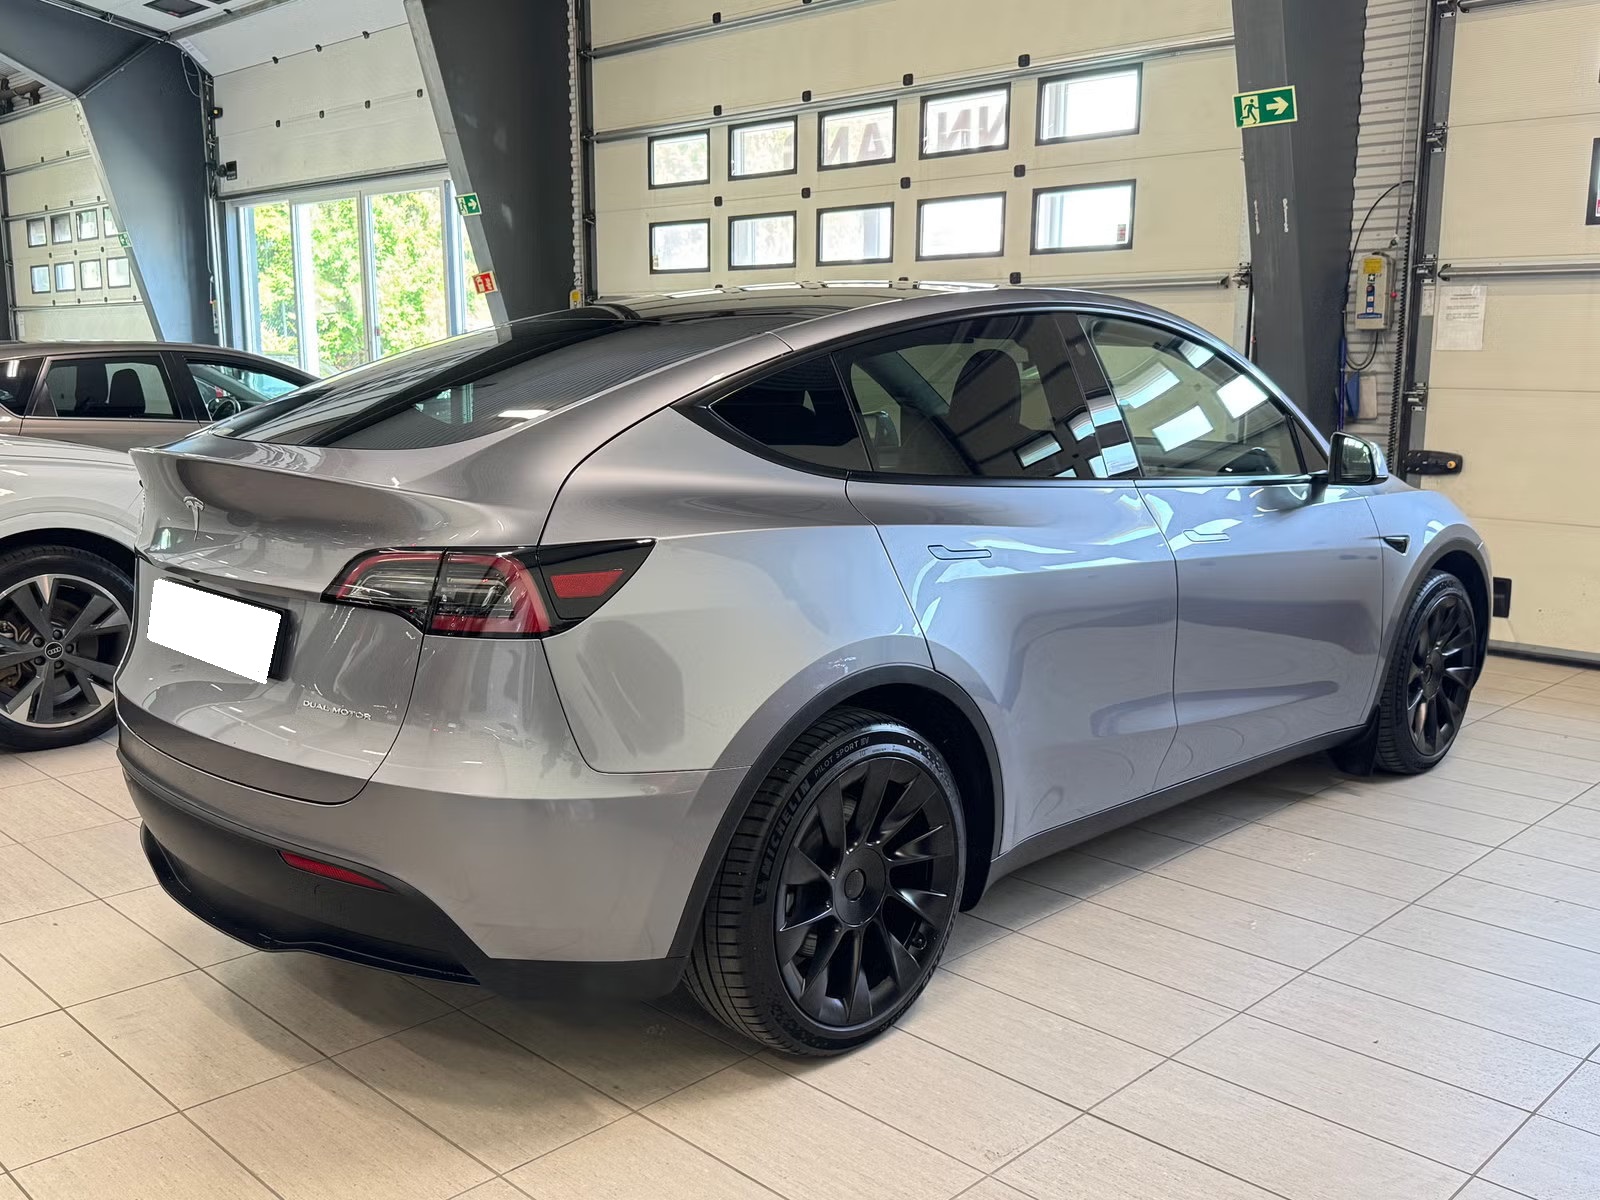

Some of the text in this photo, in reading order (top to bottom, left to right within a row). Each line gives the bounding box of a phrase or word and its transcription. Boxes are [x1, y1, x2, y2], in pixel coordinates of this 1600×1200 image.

[303, 700, 372, 721] DUAL MOTOR
[814, 755, 834, 778] PILOT
[836, 740, 859, 759] SPORT
[761, 779, 811, 877] MICHELIN
